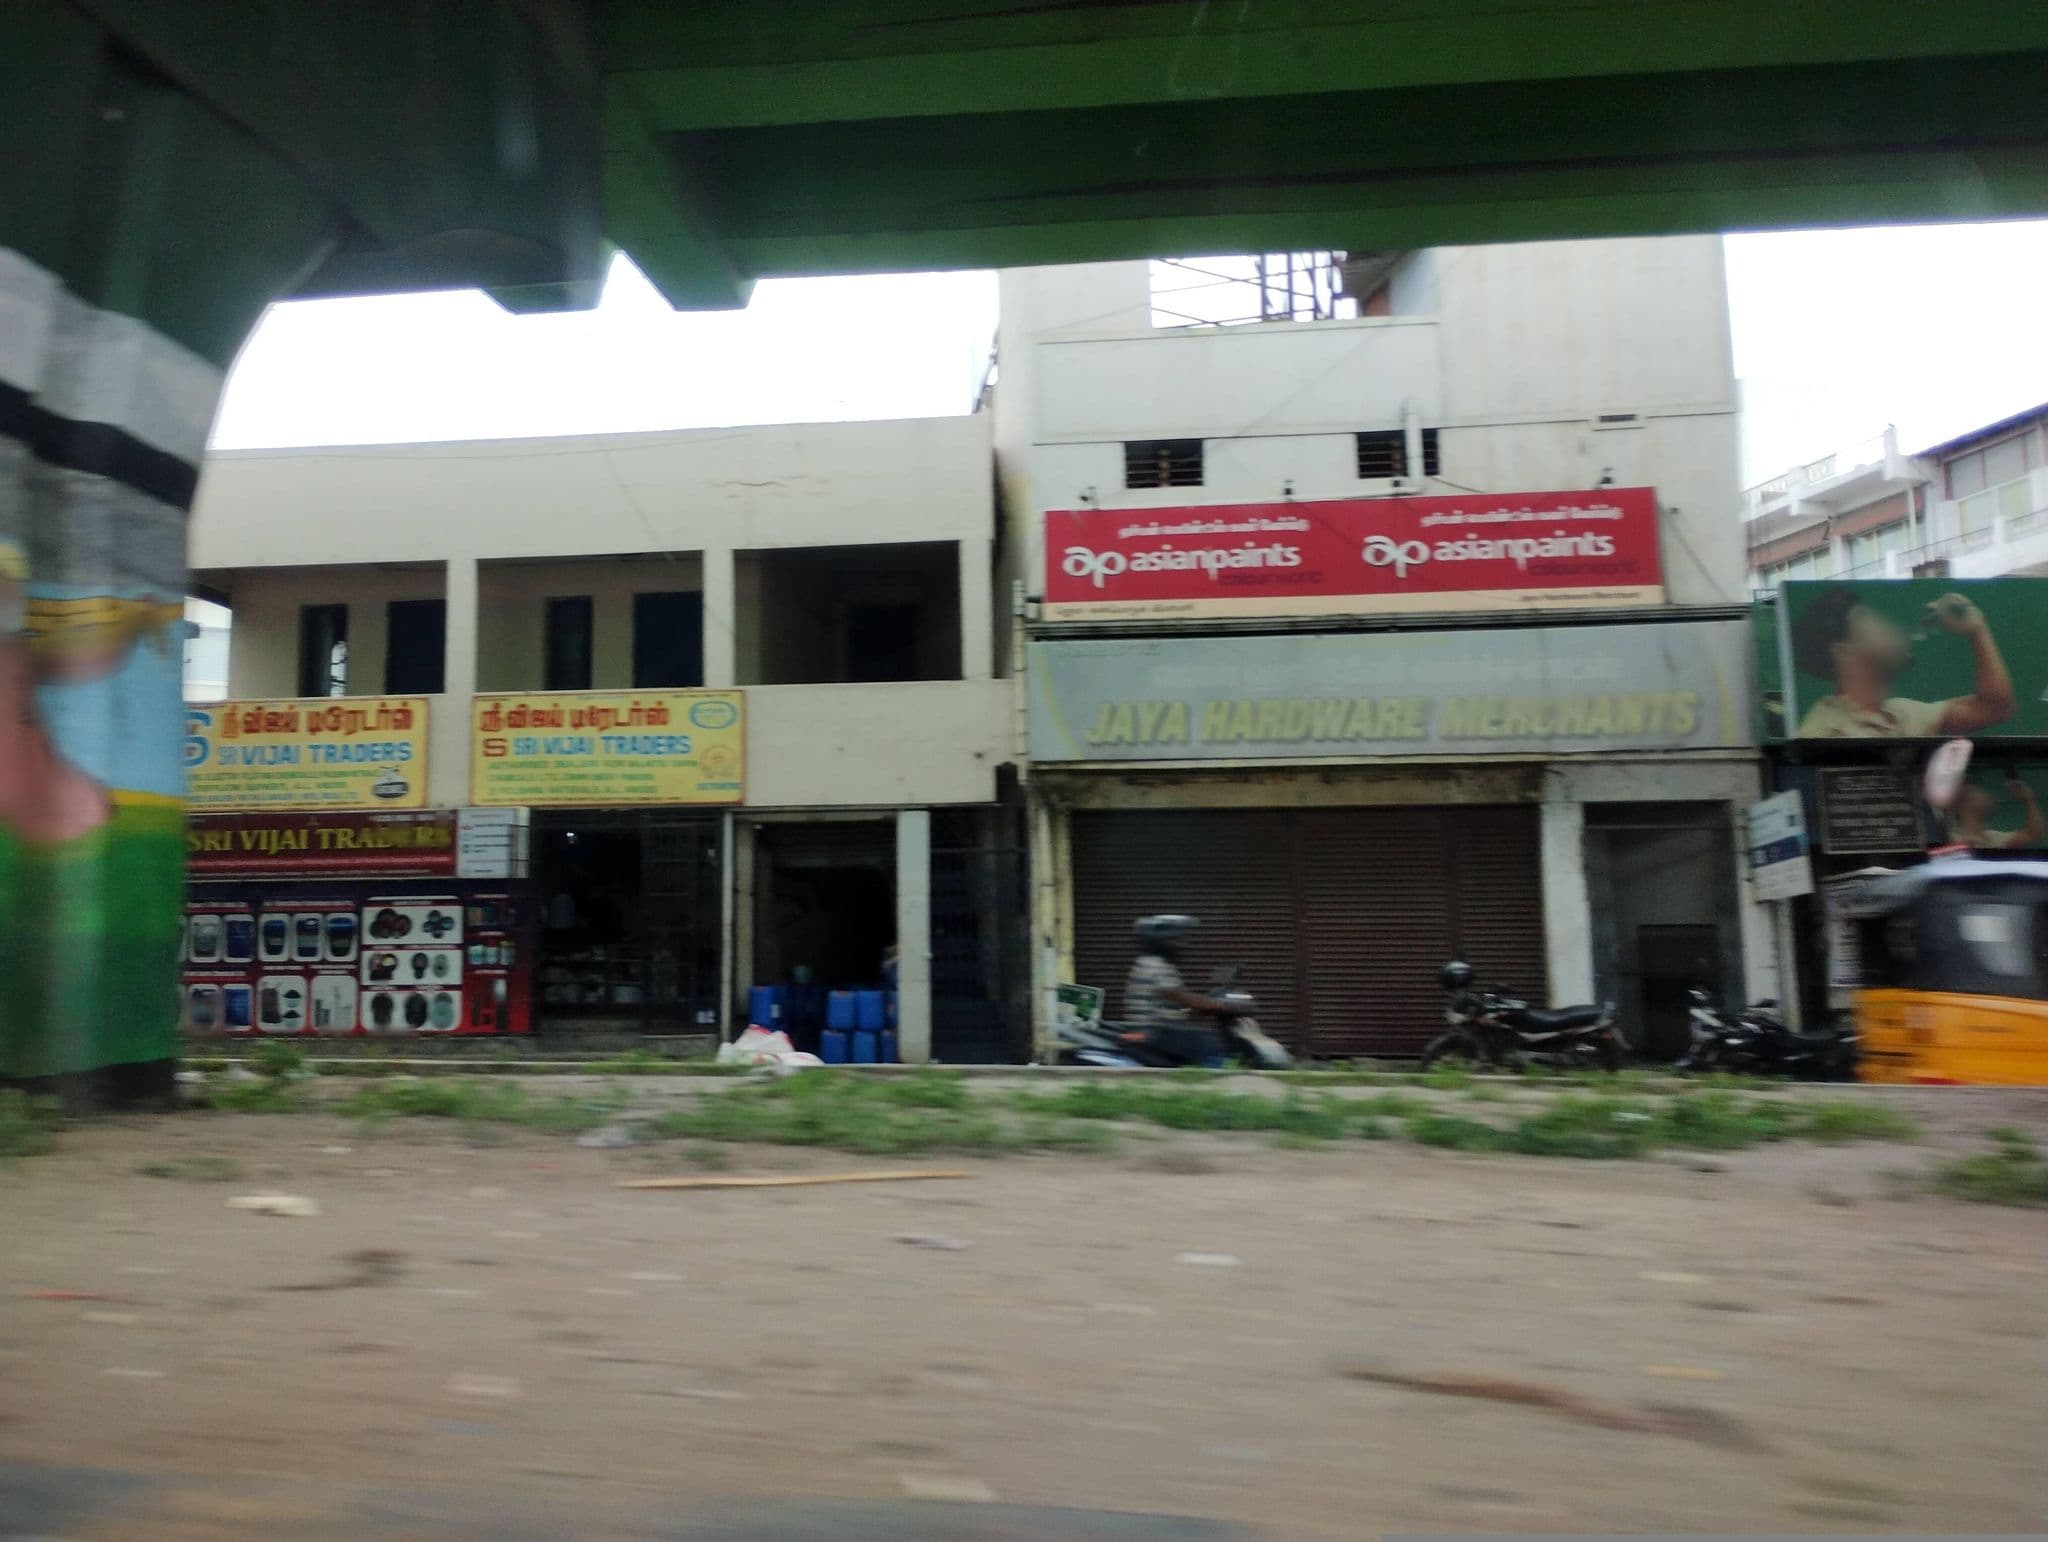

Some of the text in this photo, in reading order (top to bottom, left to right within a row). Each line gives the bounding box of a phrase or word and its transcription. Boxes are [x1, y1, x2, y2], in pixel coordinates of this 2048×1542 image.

[1130, 541, 1301, 580] asianpaints
[1433, 530, 1615, 571] asianpaints
[1085, 691, 1699, 744] JAYA HARDWARE MERCHANTS
[240, 744, 300, 765] VIJAI
[307, 741, 412, 764] TRADERS
[543, 736, 594, 755] VIJAI
[599, 735, 693, 756] TRADERS
[188, 830, 232, 851] SRI
[240, 828, 309, 855] VIJAI
